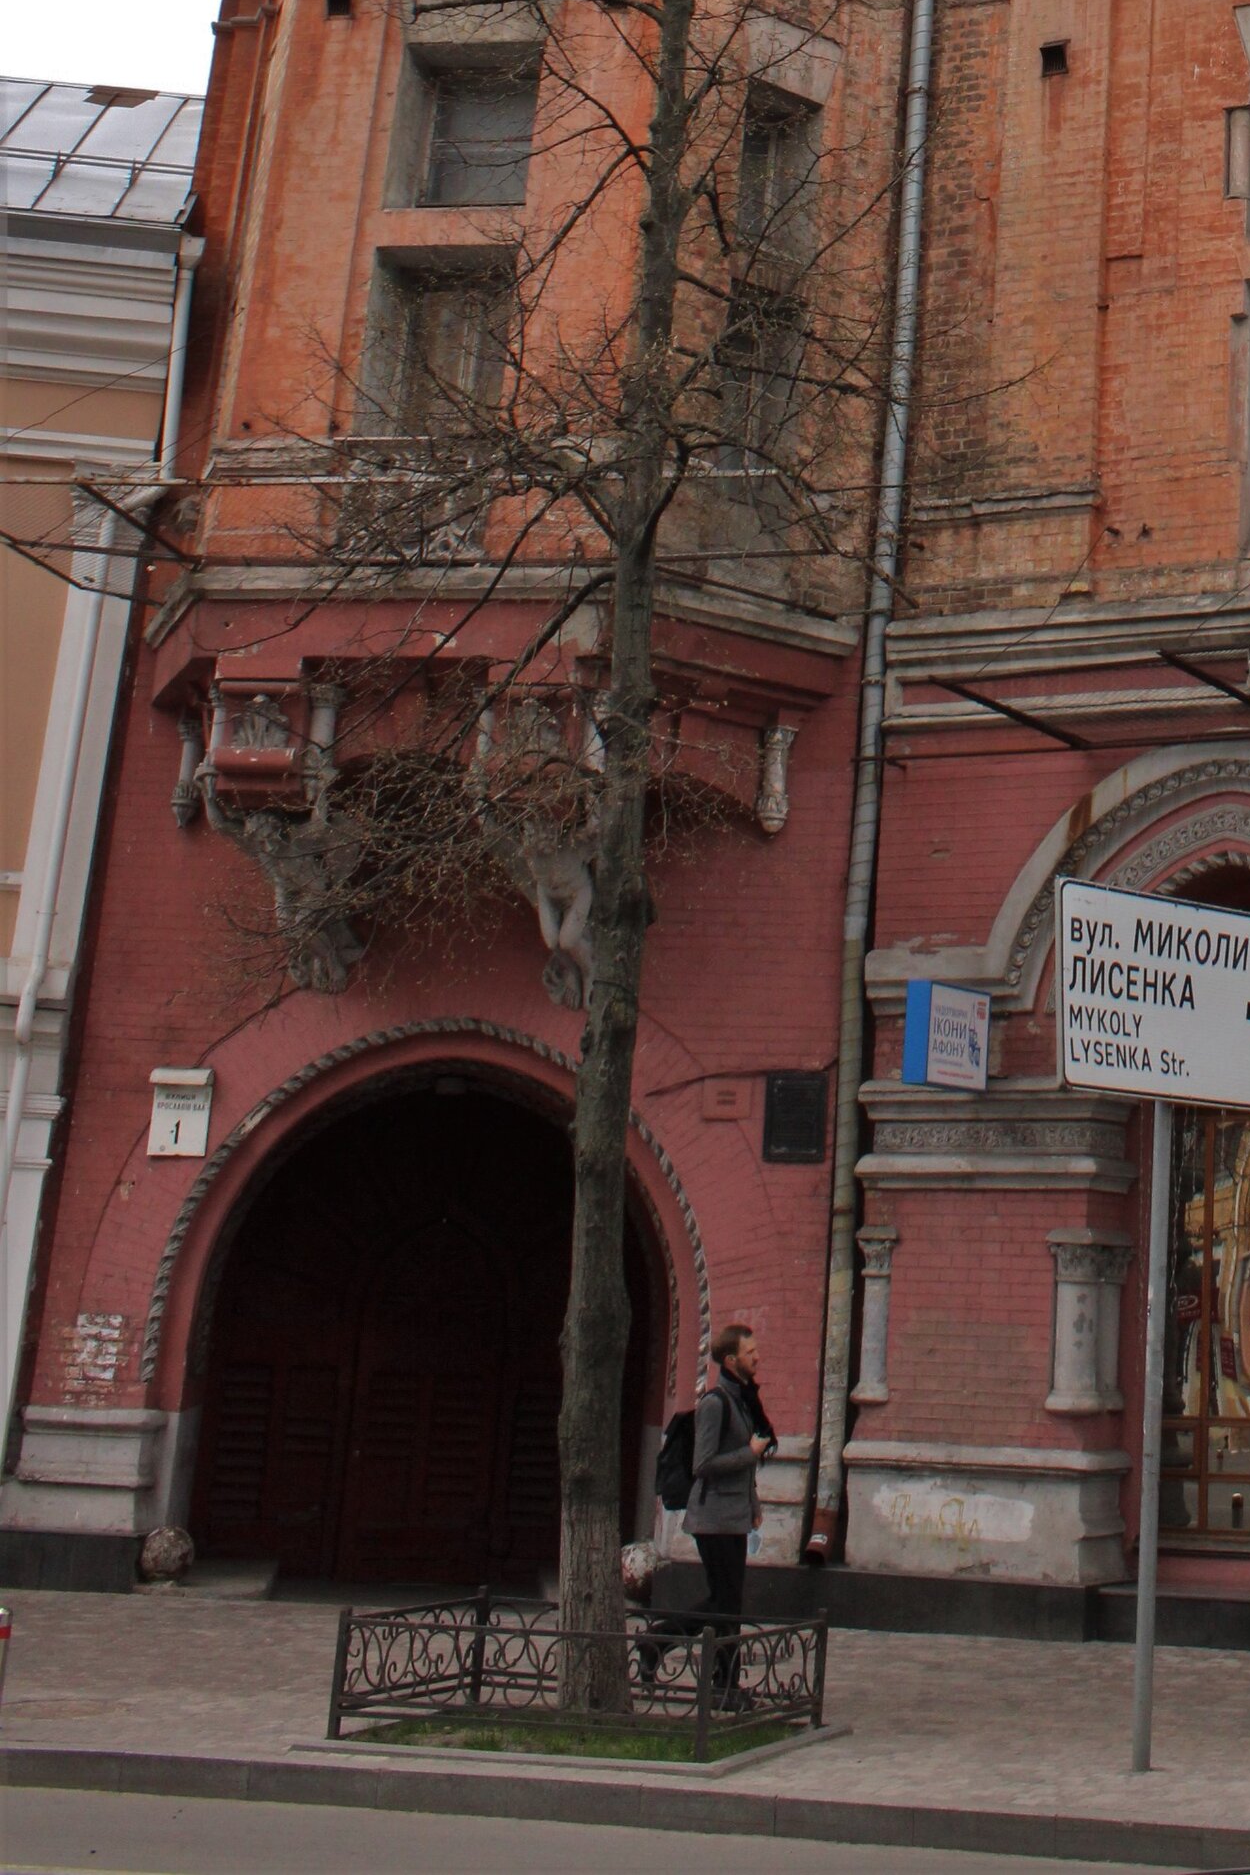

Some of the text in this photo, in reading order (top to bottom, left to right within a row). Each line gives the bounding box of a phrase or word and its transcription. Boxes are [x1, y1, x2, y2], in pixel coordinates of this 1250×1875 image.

[1070, 917, 1250, 971] вул. МИКОЛИ
[1069, 956, 1195, 1010] ЛИСЕНКА
[933, 1017, 967, 1039] ІКОНИ
[1069, 1004, 1143, 1038] MYKOLY
[932, 1039, 966, 1058] АФОНУ
[1070, 1037, 1190, 1076] LYSENKA Str.
[174, 1118, 181, 1144] 1
